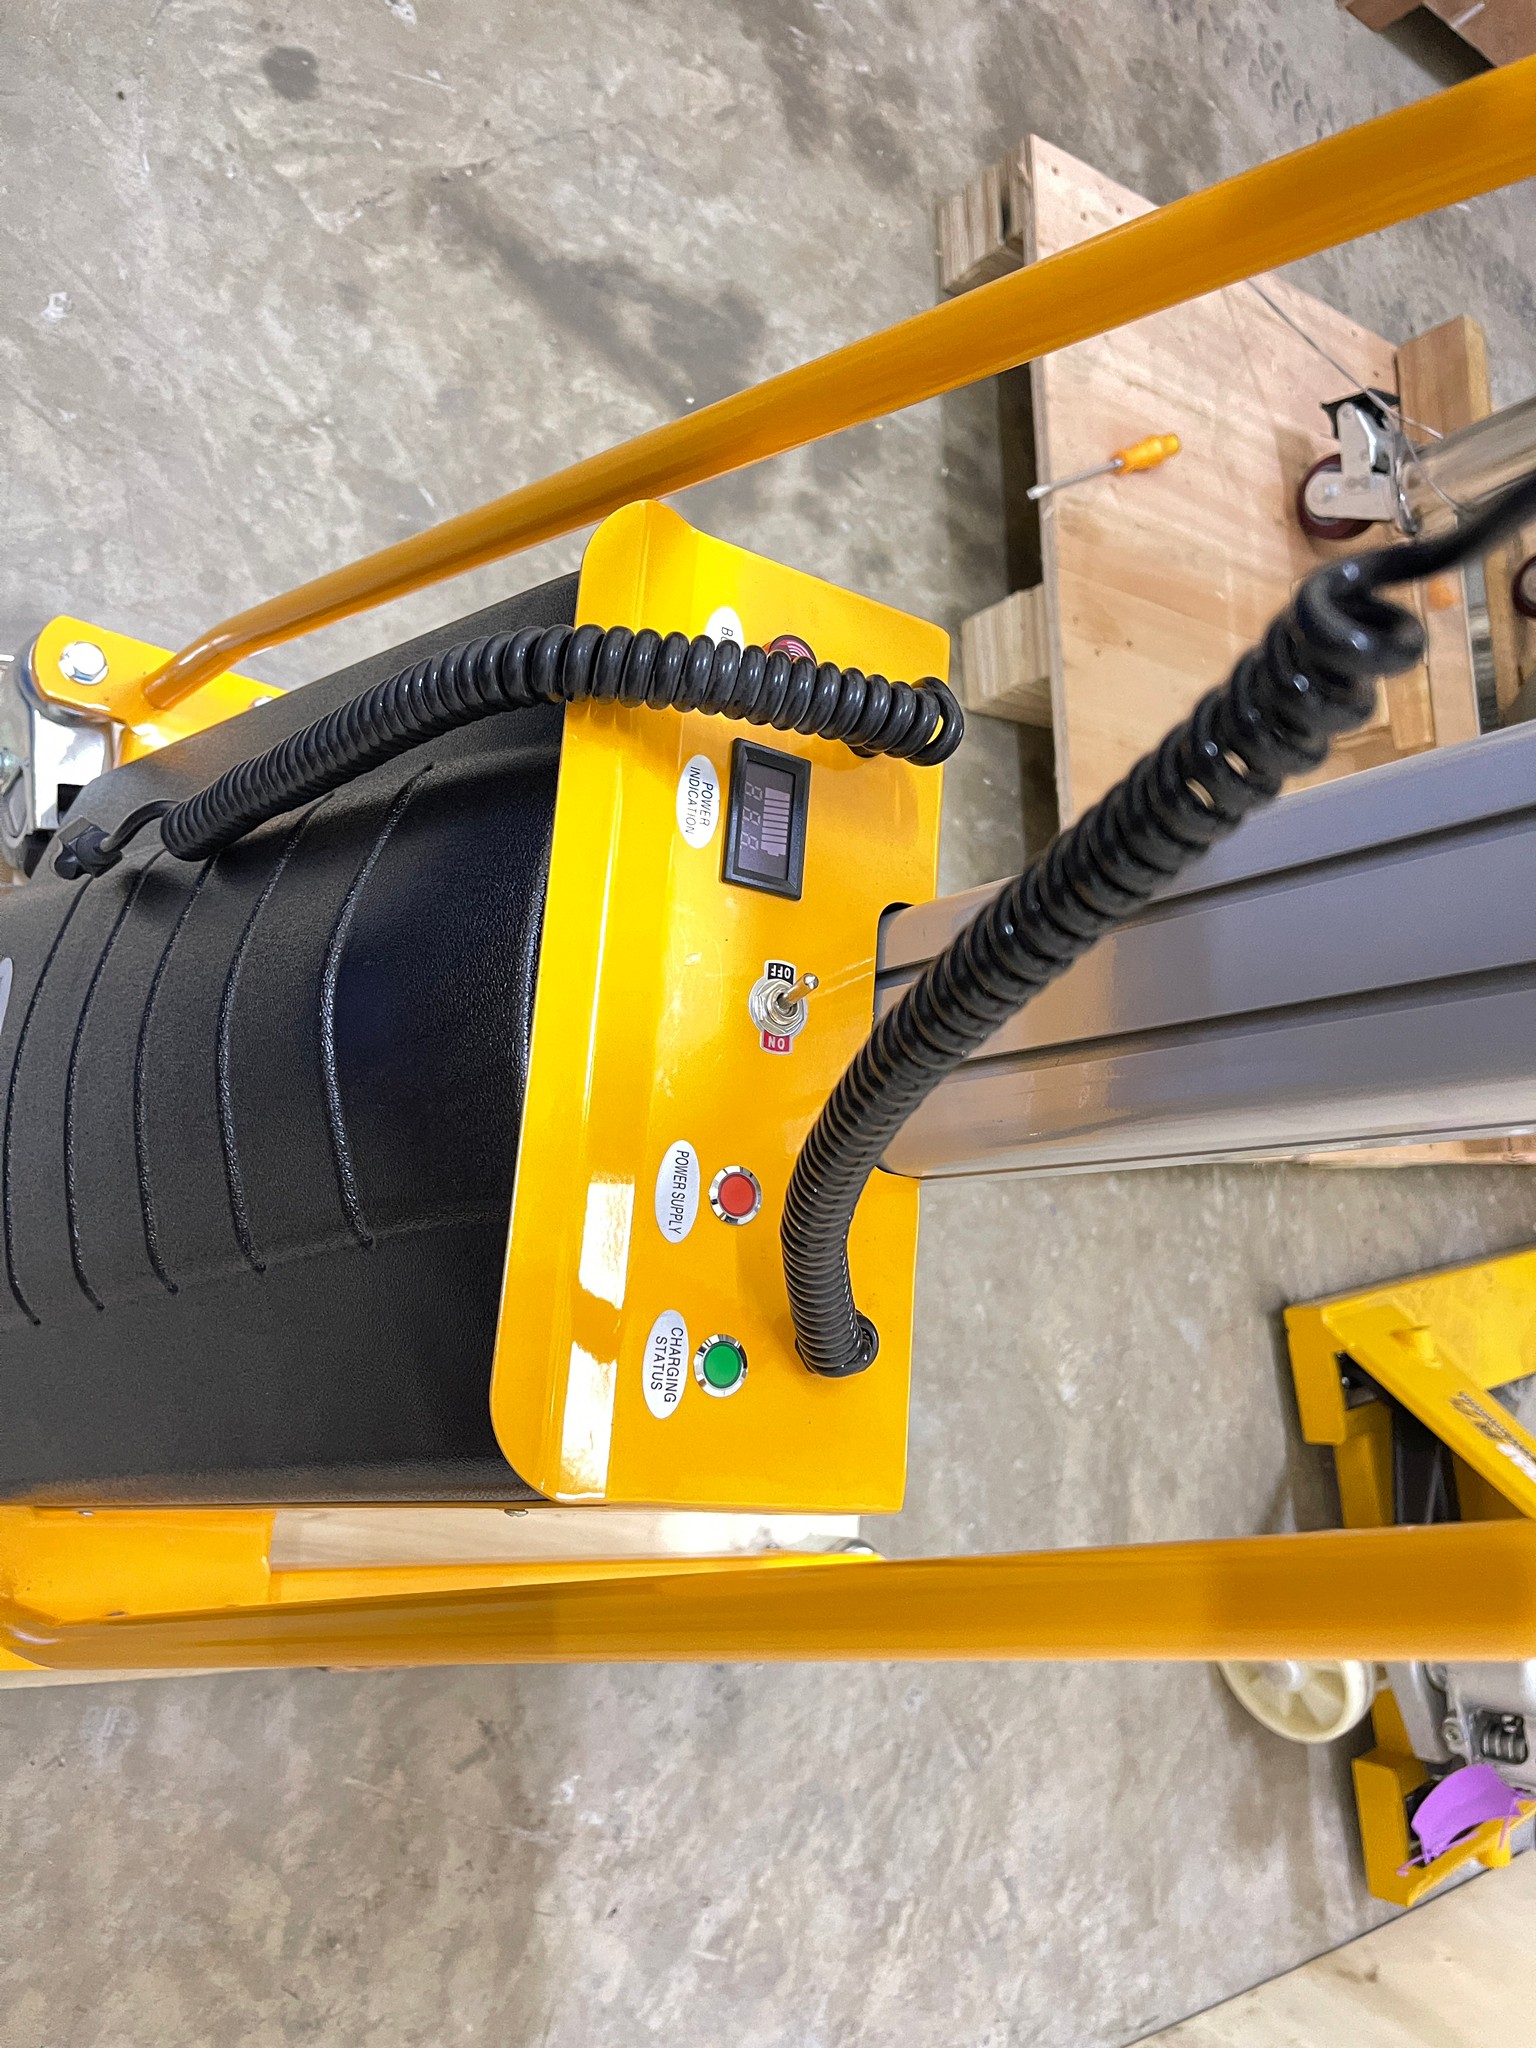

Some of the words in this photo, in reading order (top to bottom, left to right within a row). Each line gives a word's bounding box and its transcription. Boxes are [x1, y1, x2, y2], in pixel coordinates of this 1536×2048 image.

[685, 766, 701, 834] INDICATION
[700, 781, 713, 826] POWER
[770, 965, 791, 979] OFF
[768, 1036, 785, 1050] ON
[672, 1150, 690, 1190] POWER
[668, 1191, 686, 1235] SUPPLY
[650, 1336, 668, 1391] STATUS
[663, 1326, 684, 1403] CHARGING
